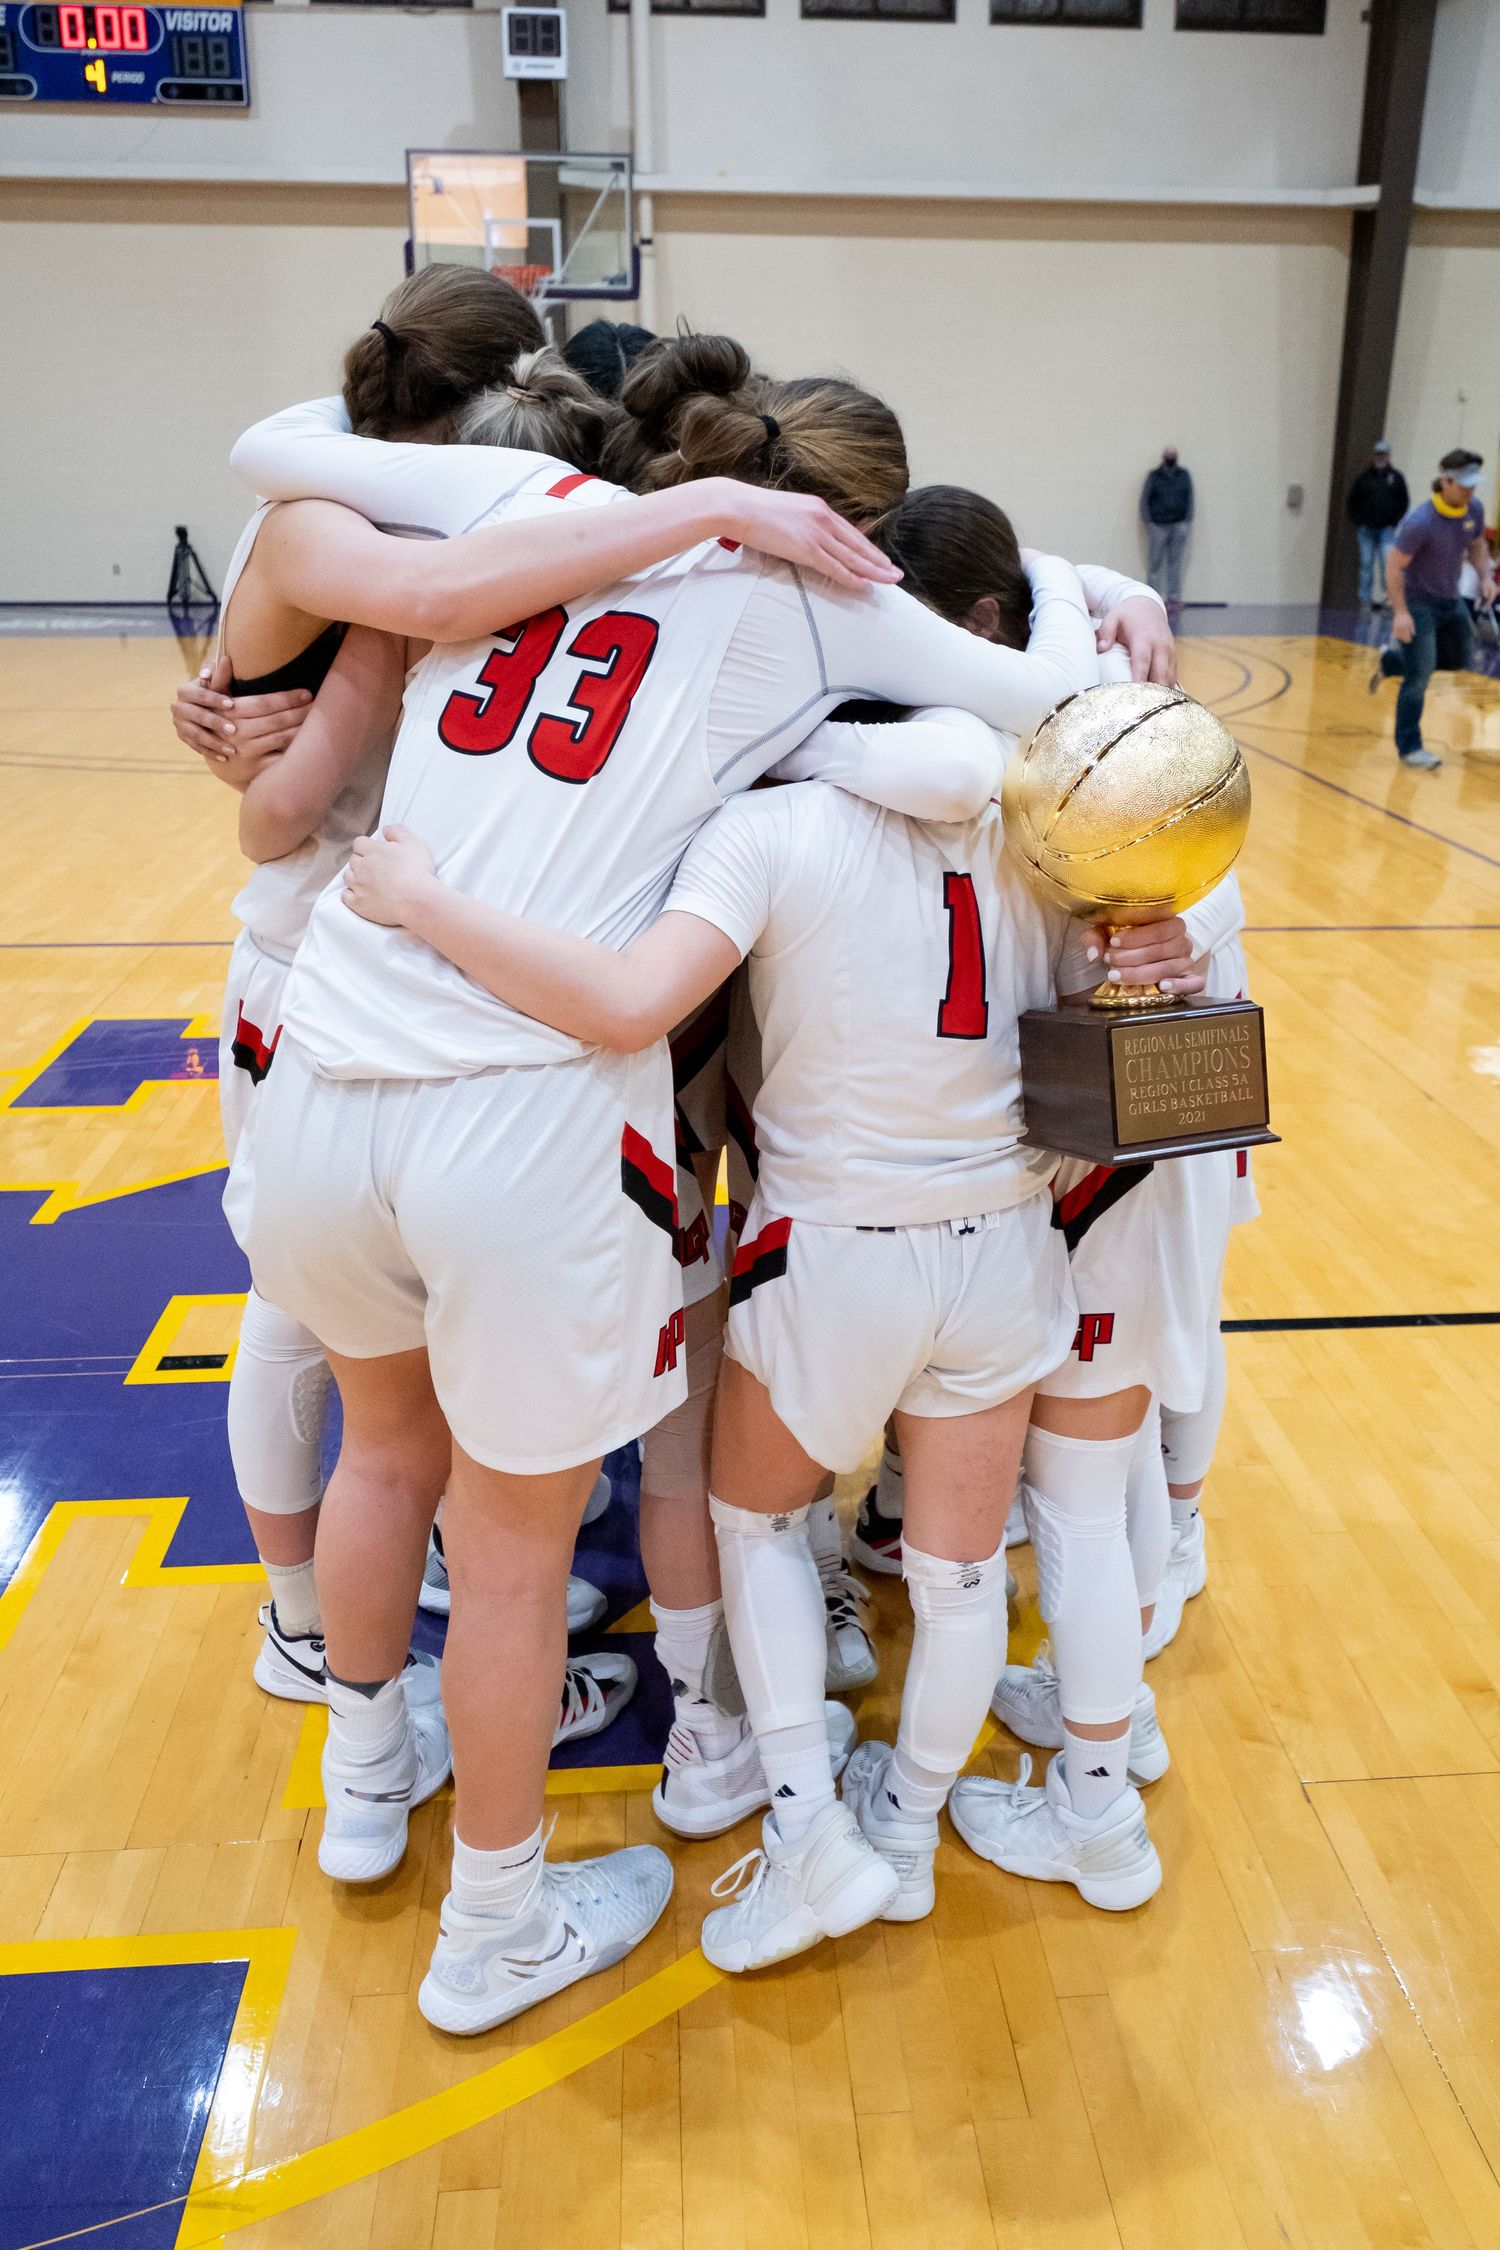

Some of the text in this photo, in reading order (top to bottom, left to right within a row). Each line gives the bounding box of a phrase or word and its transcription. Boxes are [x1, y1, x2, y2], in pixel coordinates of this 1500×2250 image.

[165, 11, 233, 33] VISITOR
[85, 59, 107, 93] 4
[111, 71, 146, 84] PERIOD
[438, 604, 660, 784] 33
[937, 871, 989, 1040] 1
[1124, 1024, 1250, 1056] REGIONAL SEMIFINALS
[1125, 1045, 1251, 1084] CHAMPIONS
[1128, 1087, 1253, 1116] GIRLS BASKETBALL
[1129, 1082, 1178, 1100] REGION
[1189, 1075, 1229, 1092] CLASS
[1231, 1073, 1249, 1086] 5A
[1178, 1110, 1206, 1125] 2021
